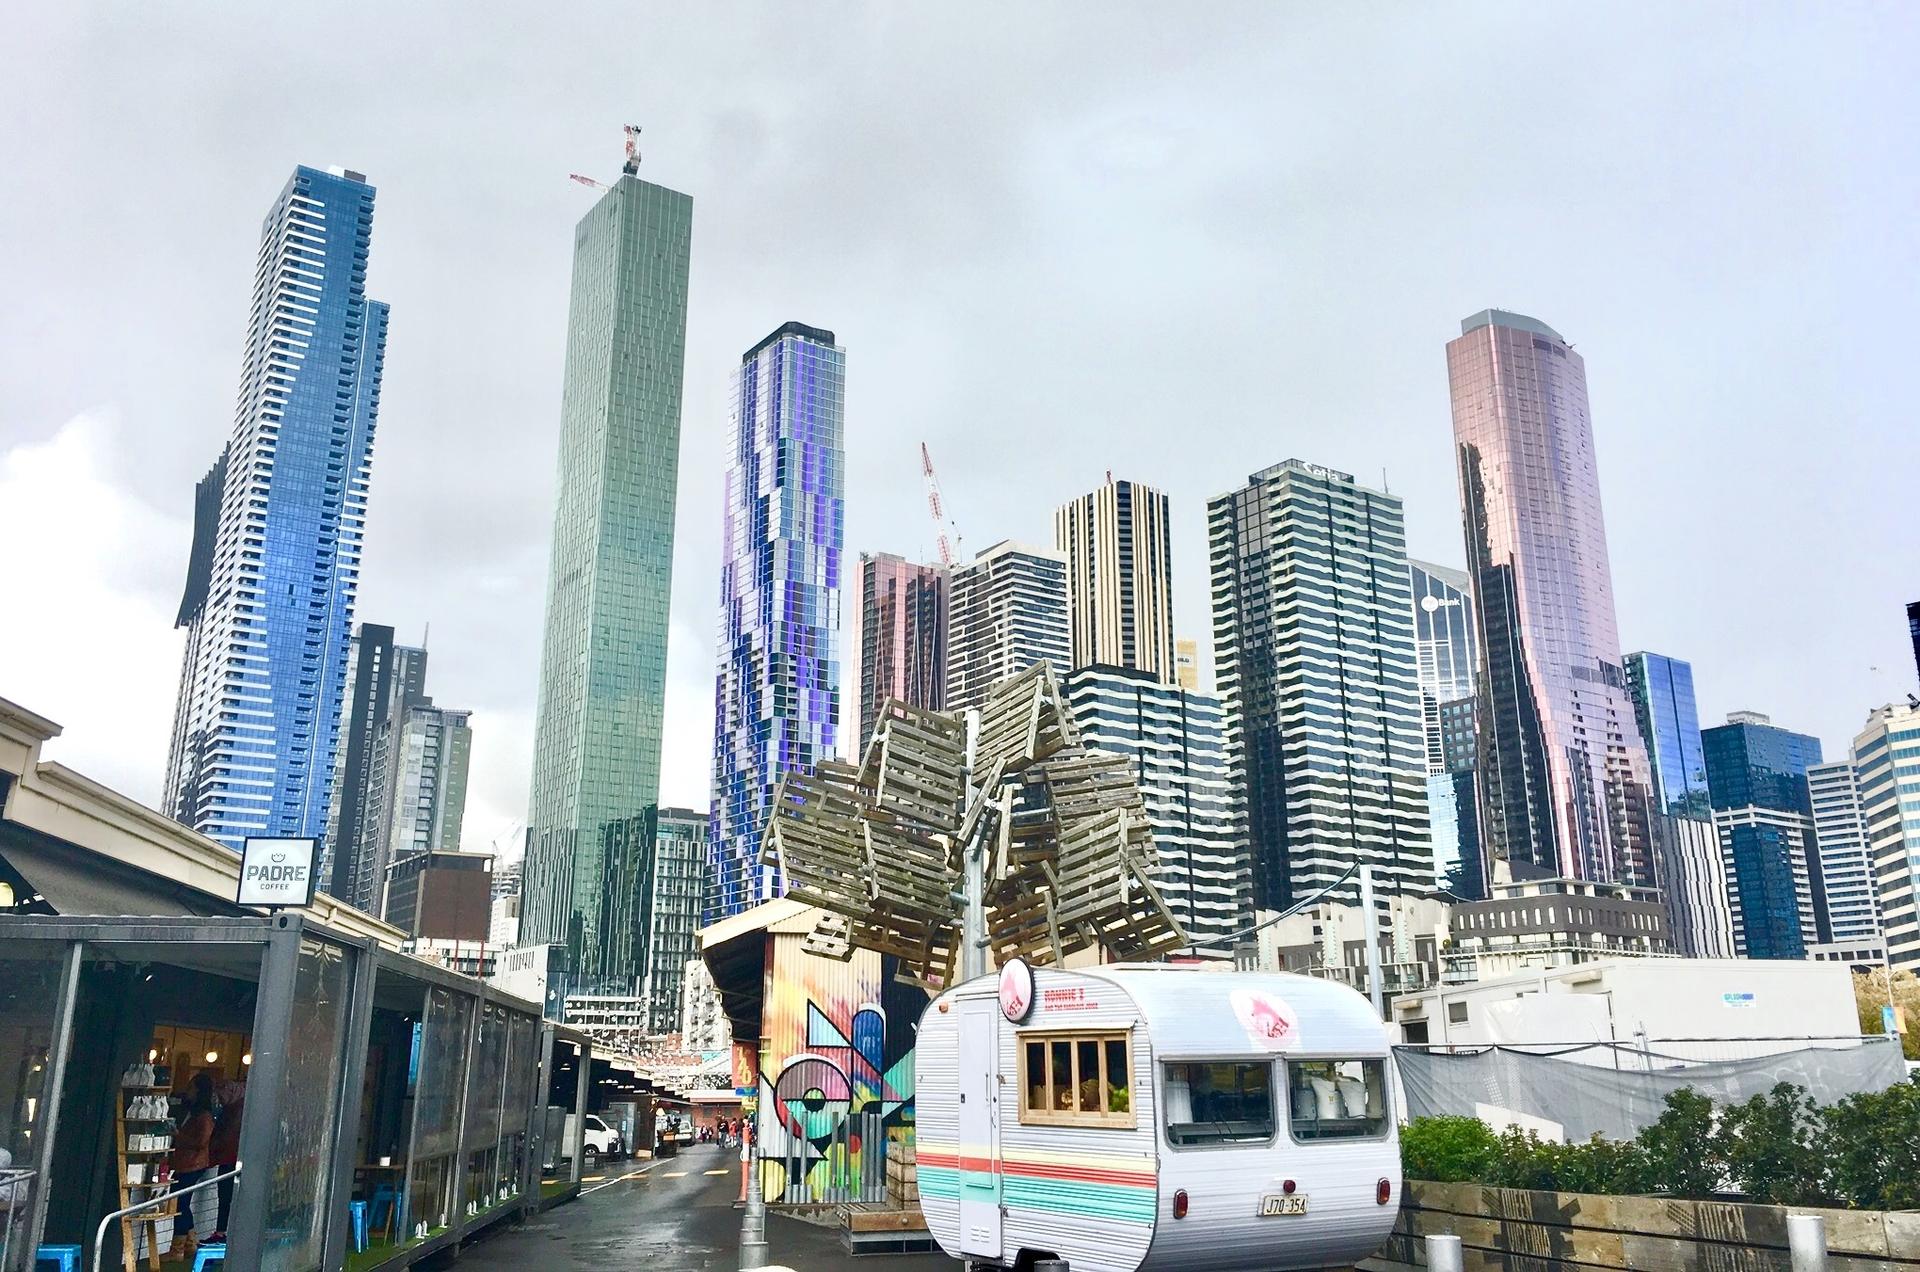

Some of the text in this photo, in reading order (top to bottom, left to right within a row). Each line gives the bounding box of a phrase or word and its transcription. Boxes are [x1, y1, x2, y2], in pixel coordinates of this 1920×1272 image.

[1438, 597, 1461, 607] Bank
[246, 865, 307, 882] PADRE
[259, 883, 290, 891] COFFEE
[1501, 1188, 1534, 1221] QUEEN
[1699, 1203, 1748, 1243] QUEEN
[1505, 1221, 1552, 1259] VICTORIA
